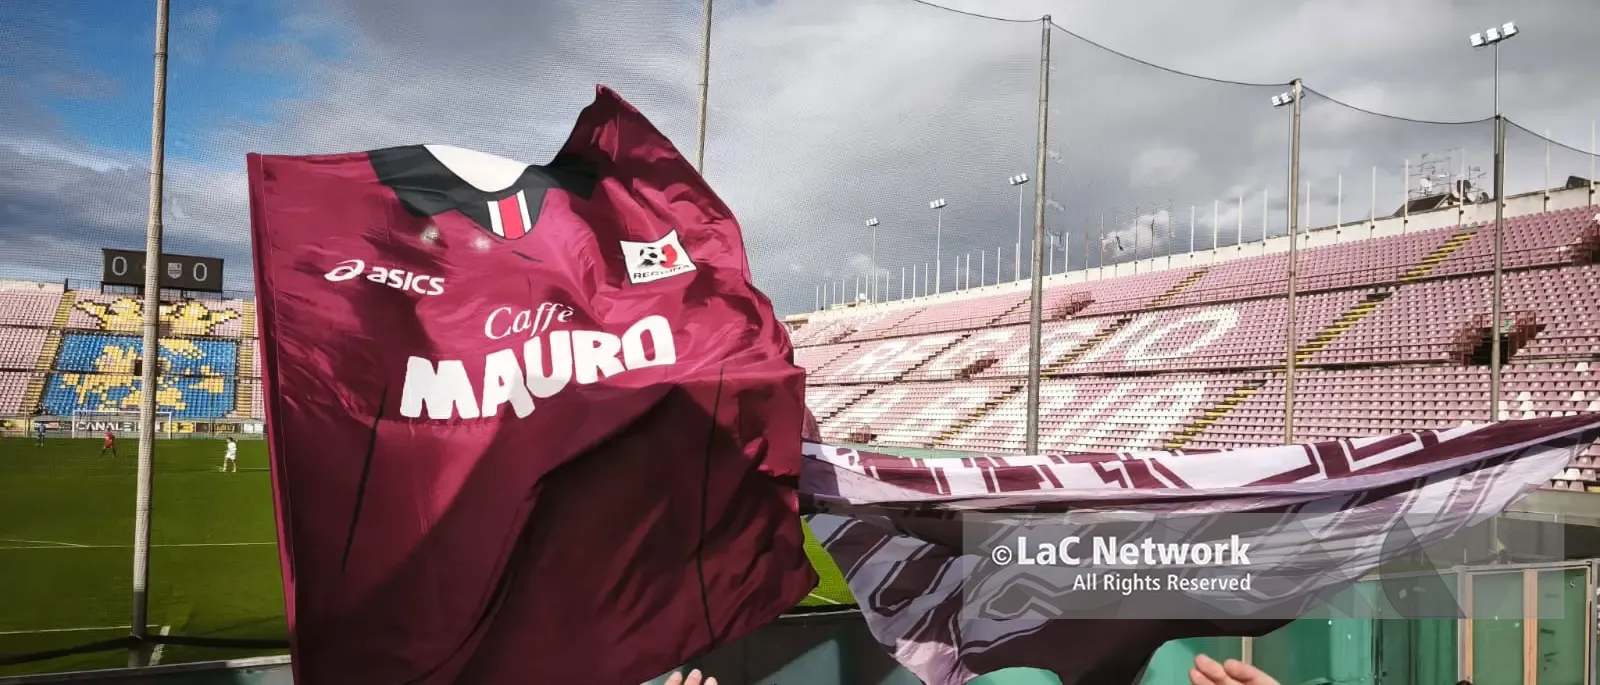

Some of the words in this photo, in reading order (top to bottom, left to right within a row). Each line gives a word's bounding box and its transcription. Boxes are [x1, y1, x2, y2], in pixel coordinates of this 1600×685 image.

[112, 256, 128, 277] 0
[193, 262, 208, 282] 0
[366, 266, 445, 296] asics
[484, 302, 575, 340] Caffè
[400, 314, 676, 419] MAURO
